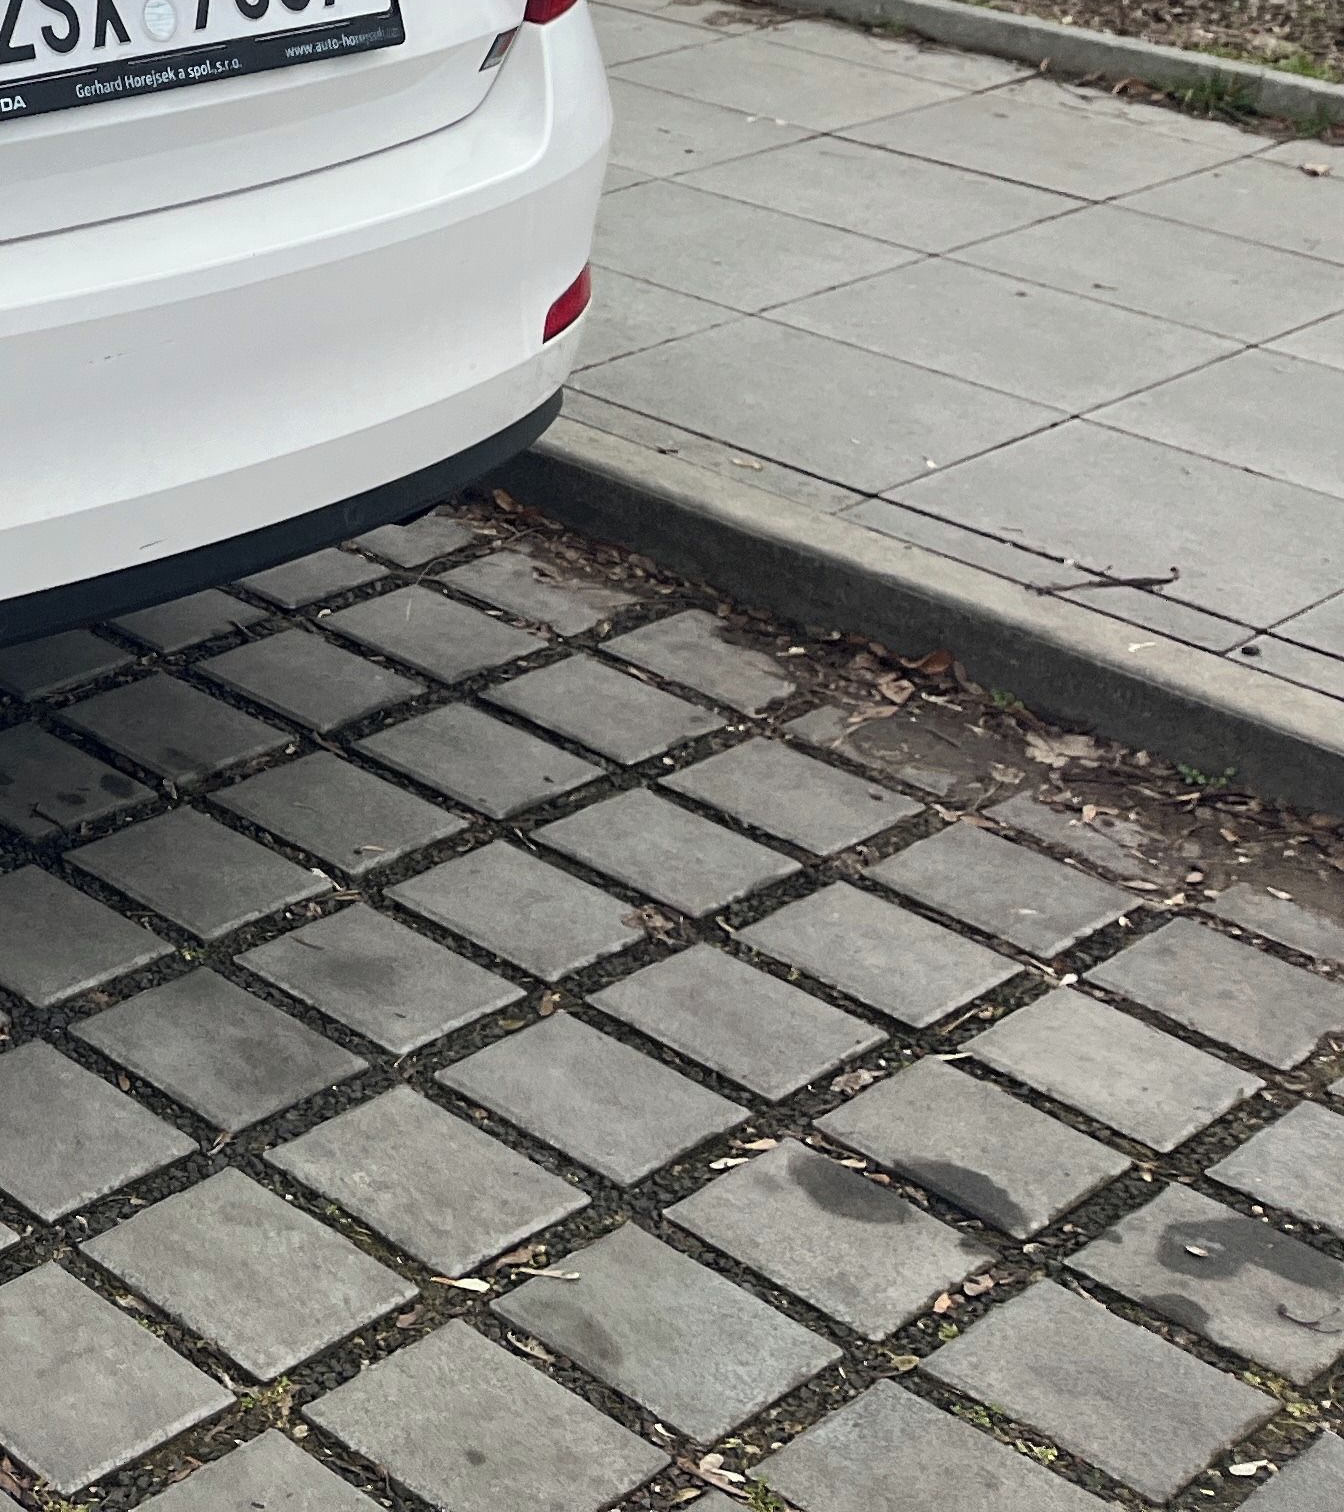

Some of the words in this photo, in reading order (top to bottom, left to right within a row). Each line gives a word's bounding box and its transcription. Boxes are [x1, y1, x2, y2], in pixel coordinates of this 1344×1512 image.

[76, 79, 123, 98] Gerhard
[125, 68, 176, 89] Horejsek
[178, 69, 186, 80] a
